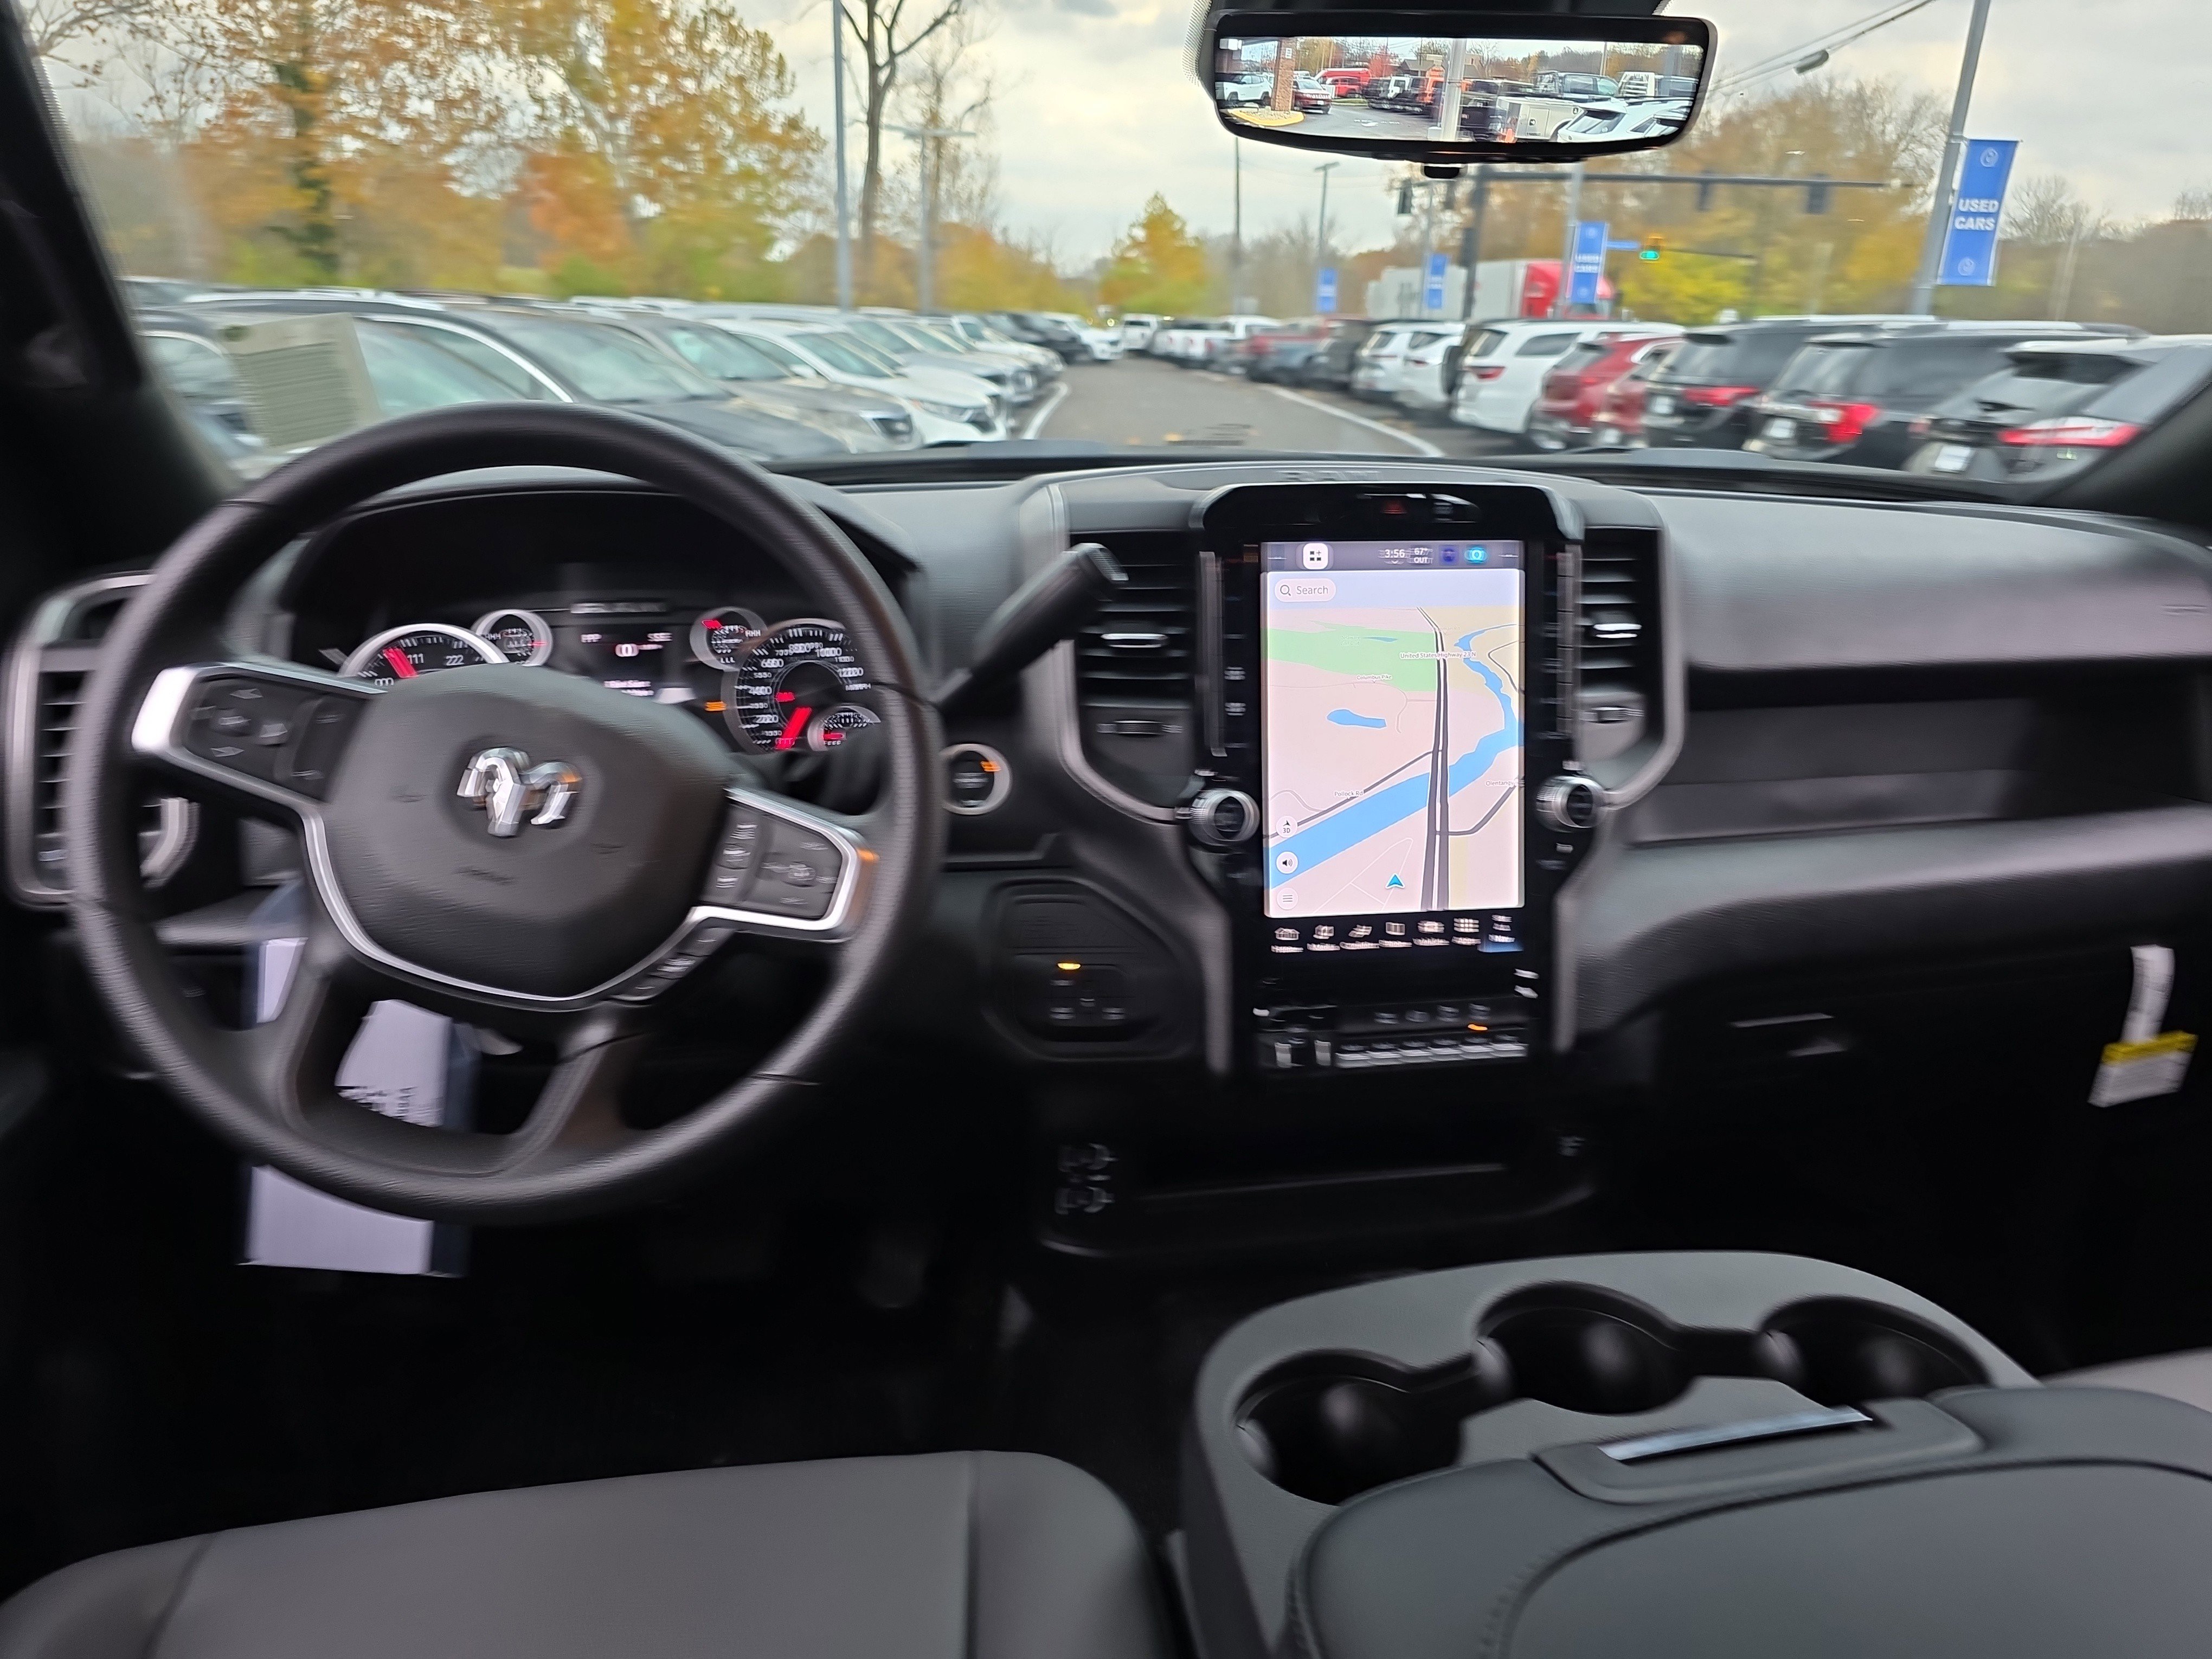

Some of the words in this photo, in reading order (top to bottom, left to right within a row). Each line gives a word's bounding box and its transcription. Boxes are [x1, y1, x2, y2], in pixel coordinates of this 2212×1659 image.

[1958, 198, 1999, 213] USED
[1954, 216, 1995, 230] CARS
[1384, 549, 1406, 558] 3:56
[1296, 585, 1329, 595] Search
